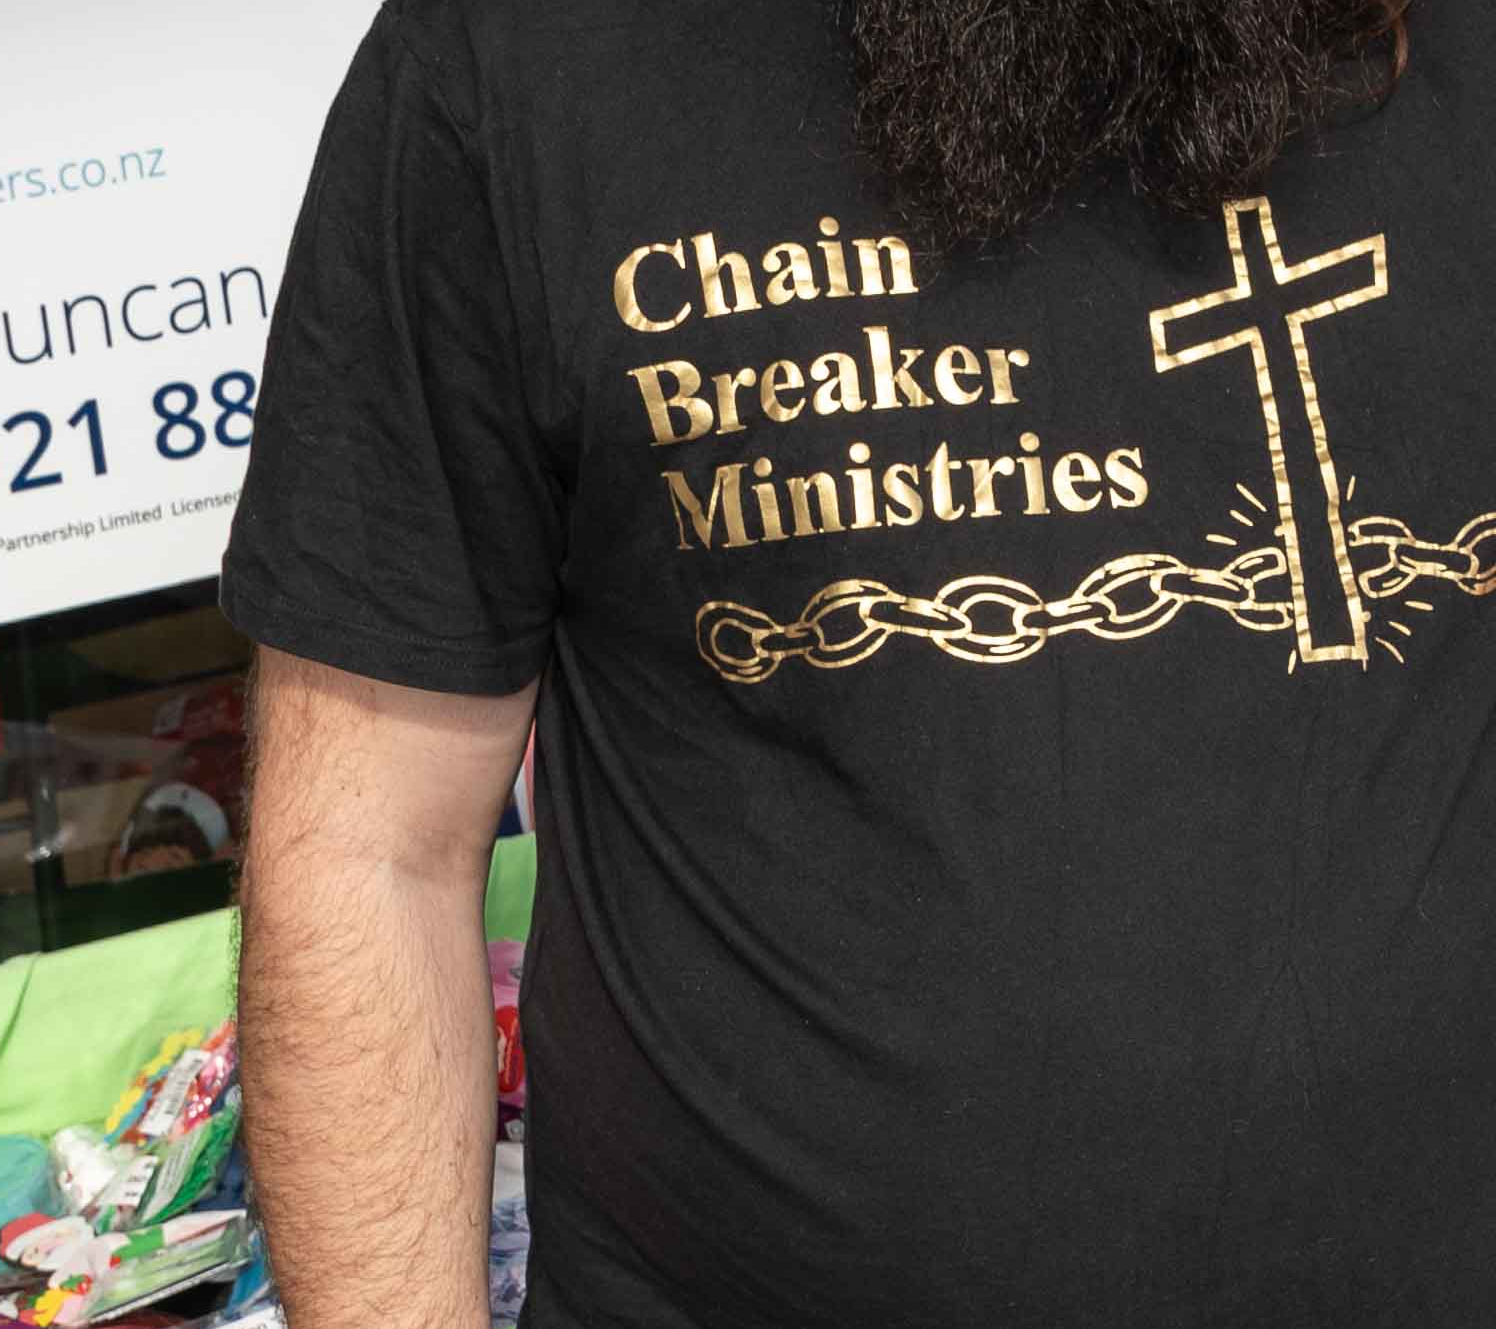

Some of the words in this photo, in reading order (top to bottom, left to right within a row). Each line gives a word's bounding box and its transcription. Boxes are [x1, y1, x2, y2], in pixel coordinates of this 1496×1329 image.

[613, 216, 919, 332] Chain
[628, 326, 1030, 447] Breaker
[100, 505, 163, 532] Limited
[661, 431, 1151, 552] Ministries
